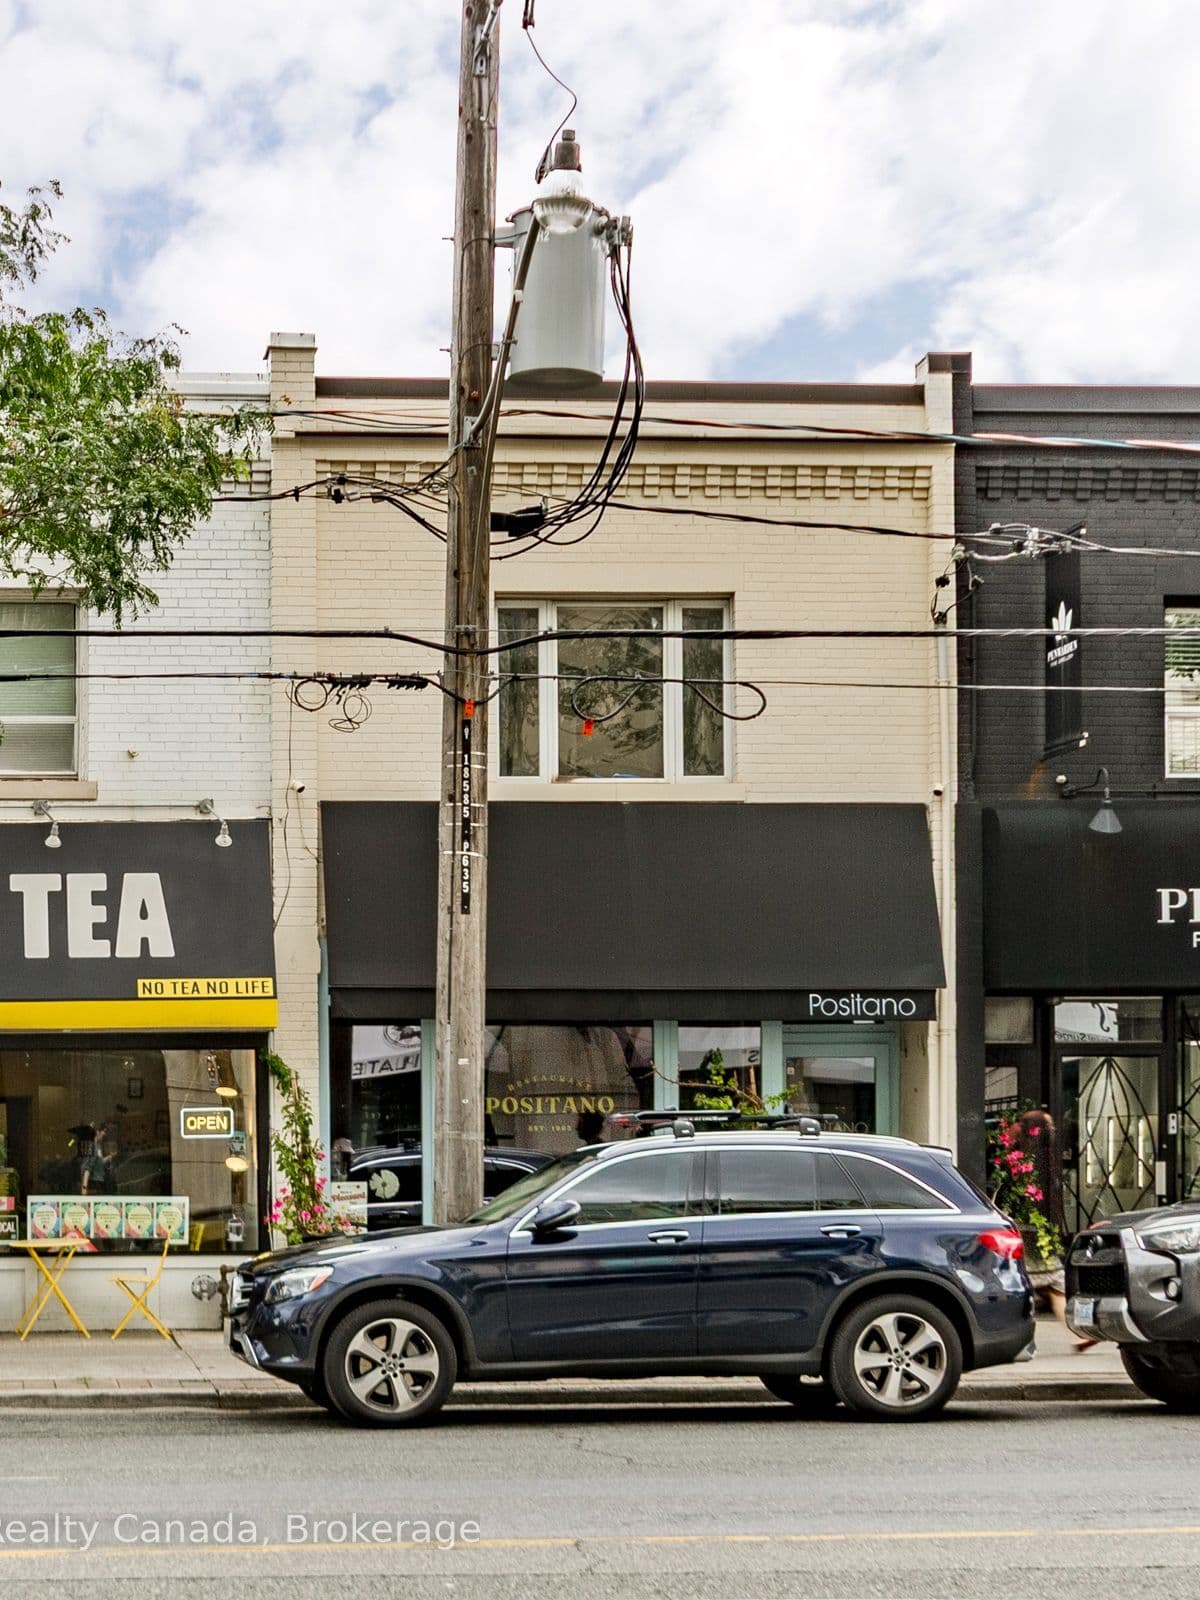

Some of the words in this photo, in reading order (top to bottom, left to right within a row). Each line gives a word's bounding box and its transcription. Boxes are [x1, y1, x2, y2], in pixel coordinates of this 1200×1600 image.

[9, 873, 175, 959] TEA
[142, 982, 164, 995] NO
[171, 981, 200, 994] TEA
[207, 981, 228, 994] NO
[236, 980, 269, 994] LIFE
[809, 993, 916, 1016] Positano
[486, 1096, 615, 1114] POSITANO
[186, 1116, 228, 1130] OPEN
